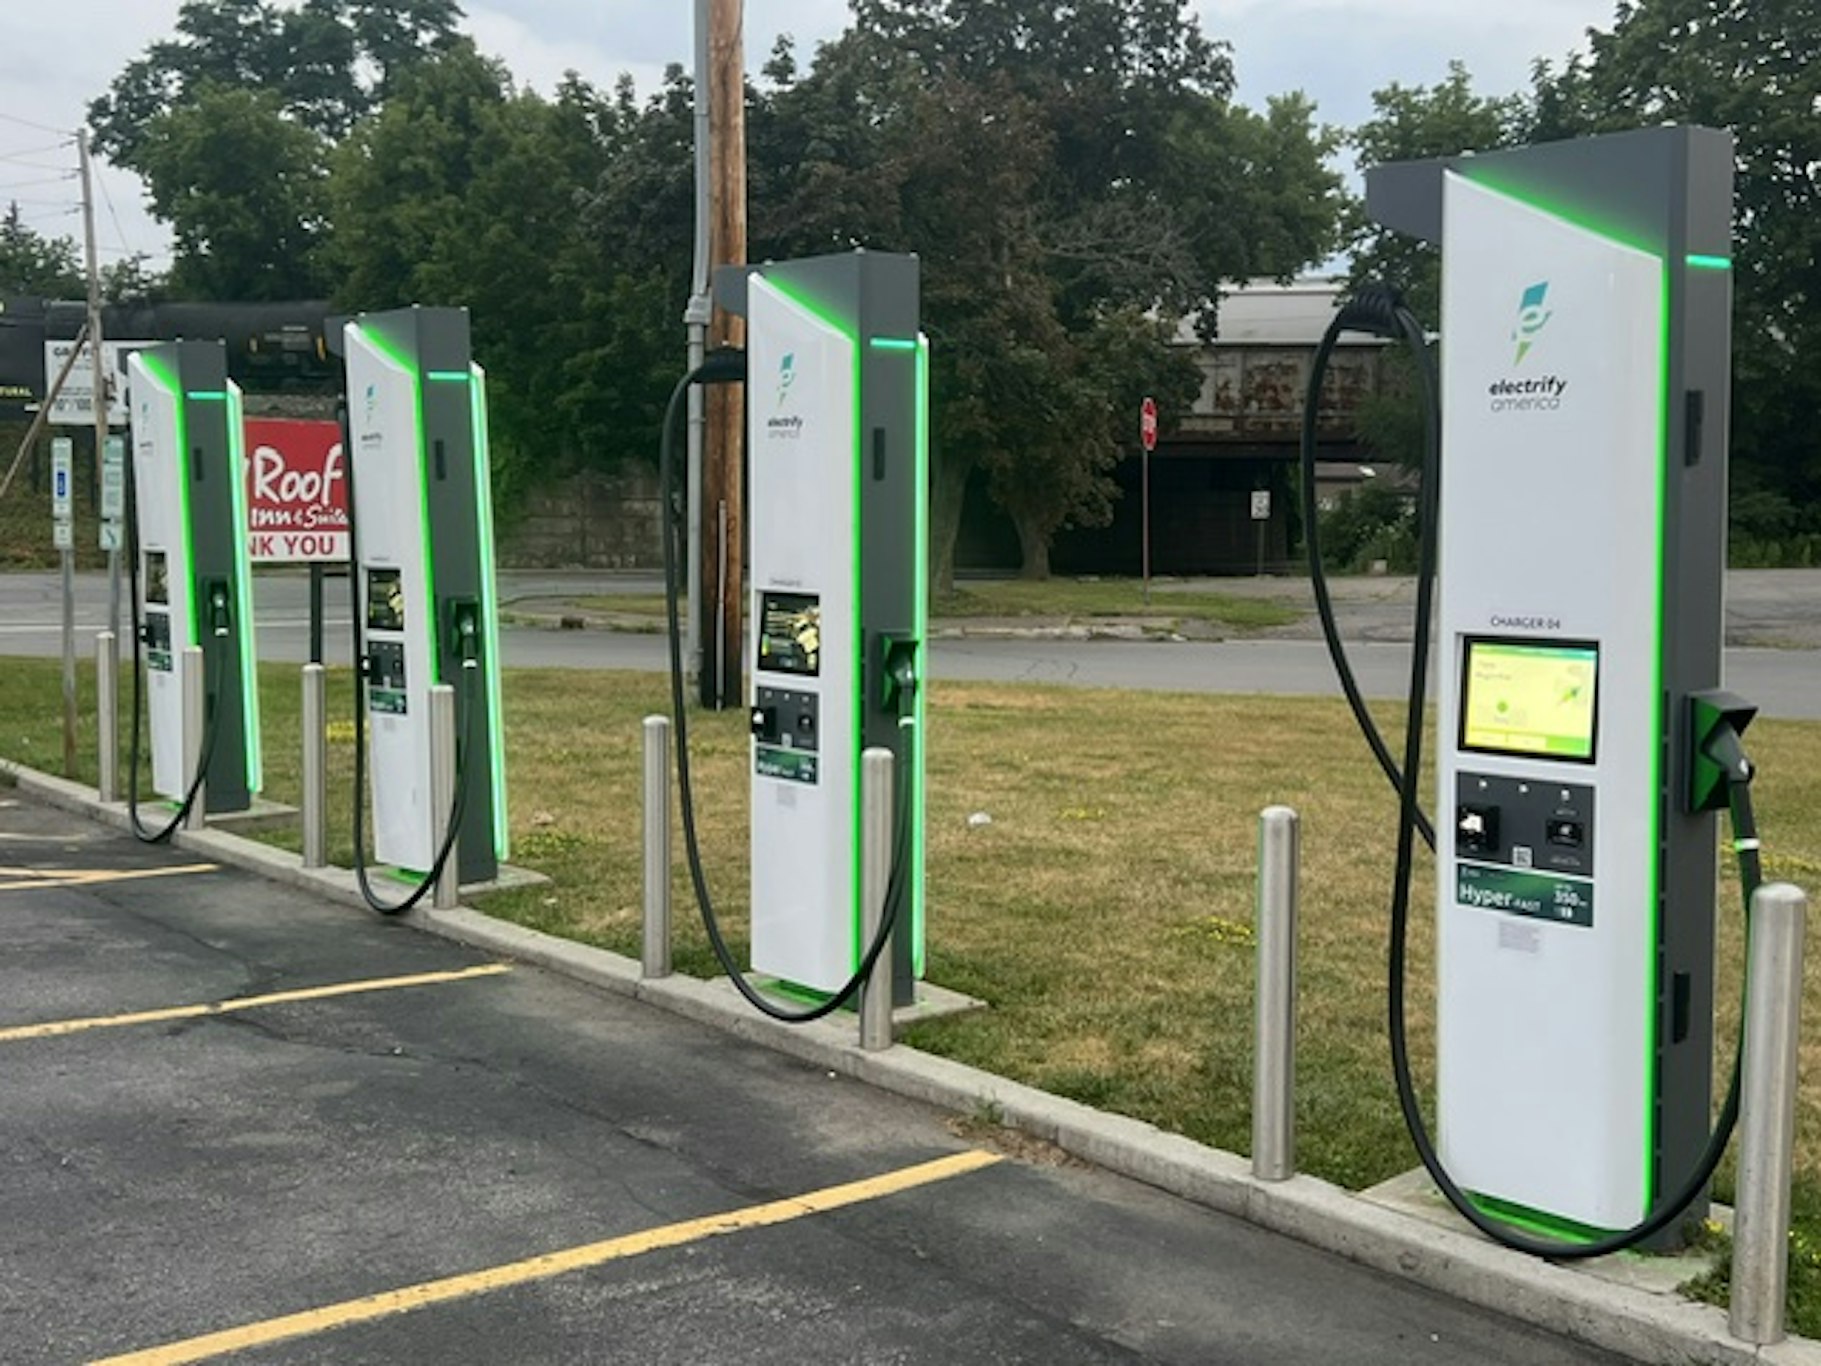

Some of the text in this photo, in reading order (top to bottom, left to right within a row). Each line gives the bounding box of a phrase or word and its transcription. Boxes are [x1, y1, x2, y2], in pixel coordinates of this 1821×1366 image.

[1489, 376, 1568, 396] electrify
[1490, 395, 1561, 413] america
[253, 443, 343, 507] Roof
[251, 507, 293, 527] Inn
[284, 536, 335, 556] YOU
[1490, 615, 1544, 629] CHARGER
[1459, 883, 1513, 907] Hyper
